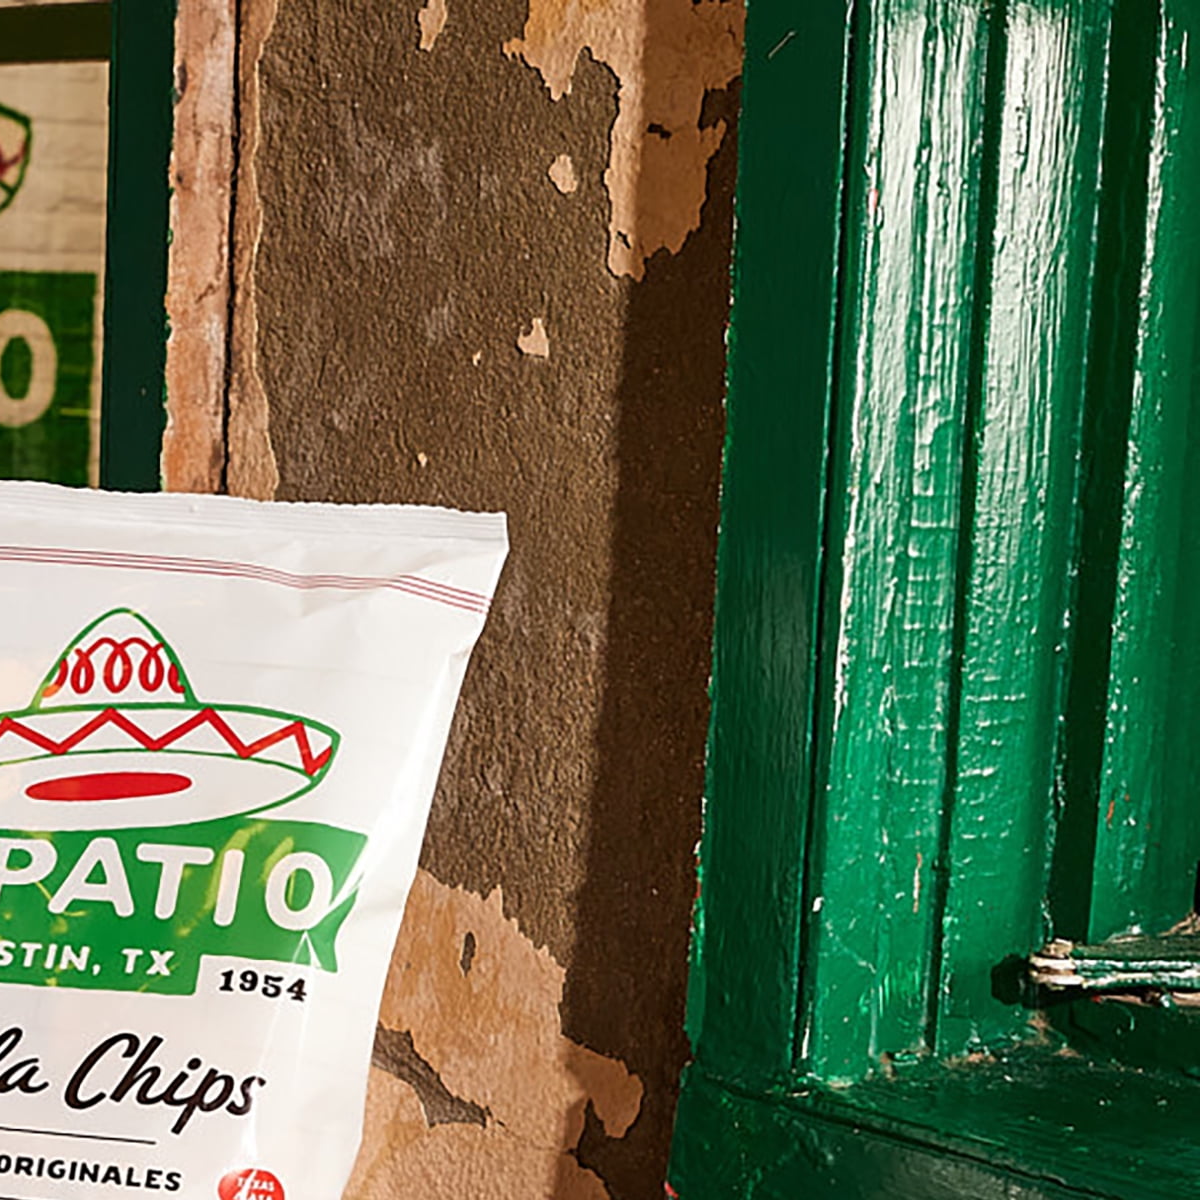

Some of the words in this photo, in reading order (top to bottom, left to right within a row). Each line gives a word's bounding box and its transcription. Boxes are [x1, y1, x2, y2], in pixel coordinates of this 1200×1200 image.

[121, 946, 176, 977] TX
[218, 969, 308, 1003] 1954
[63, 1031, 267, 1136] Chips
